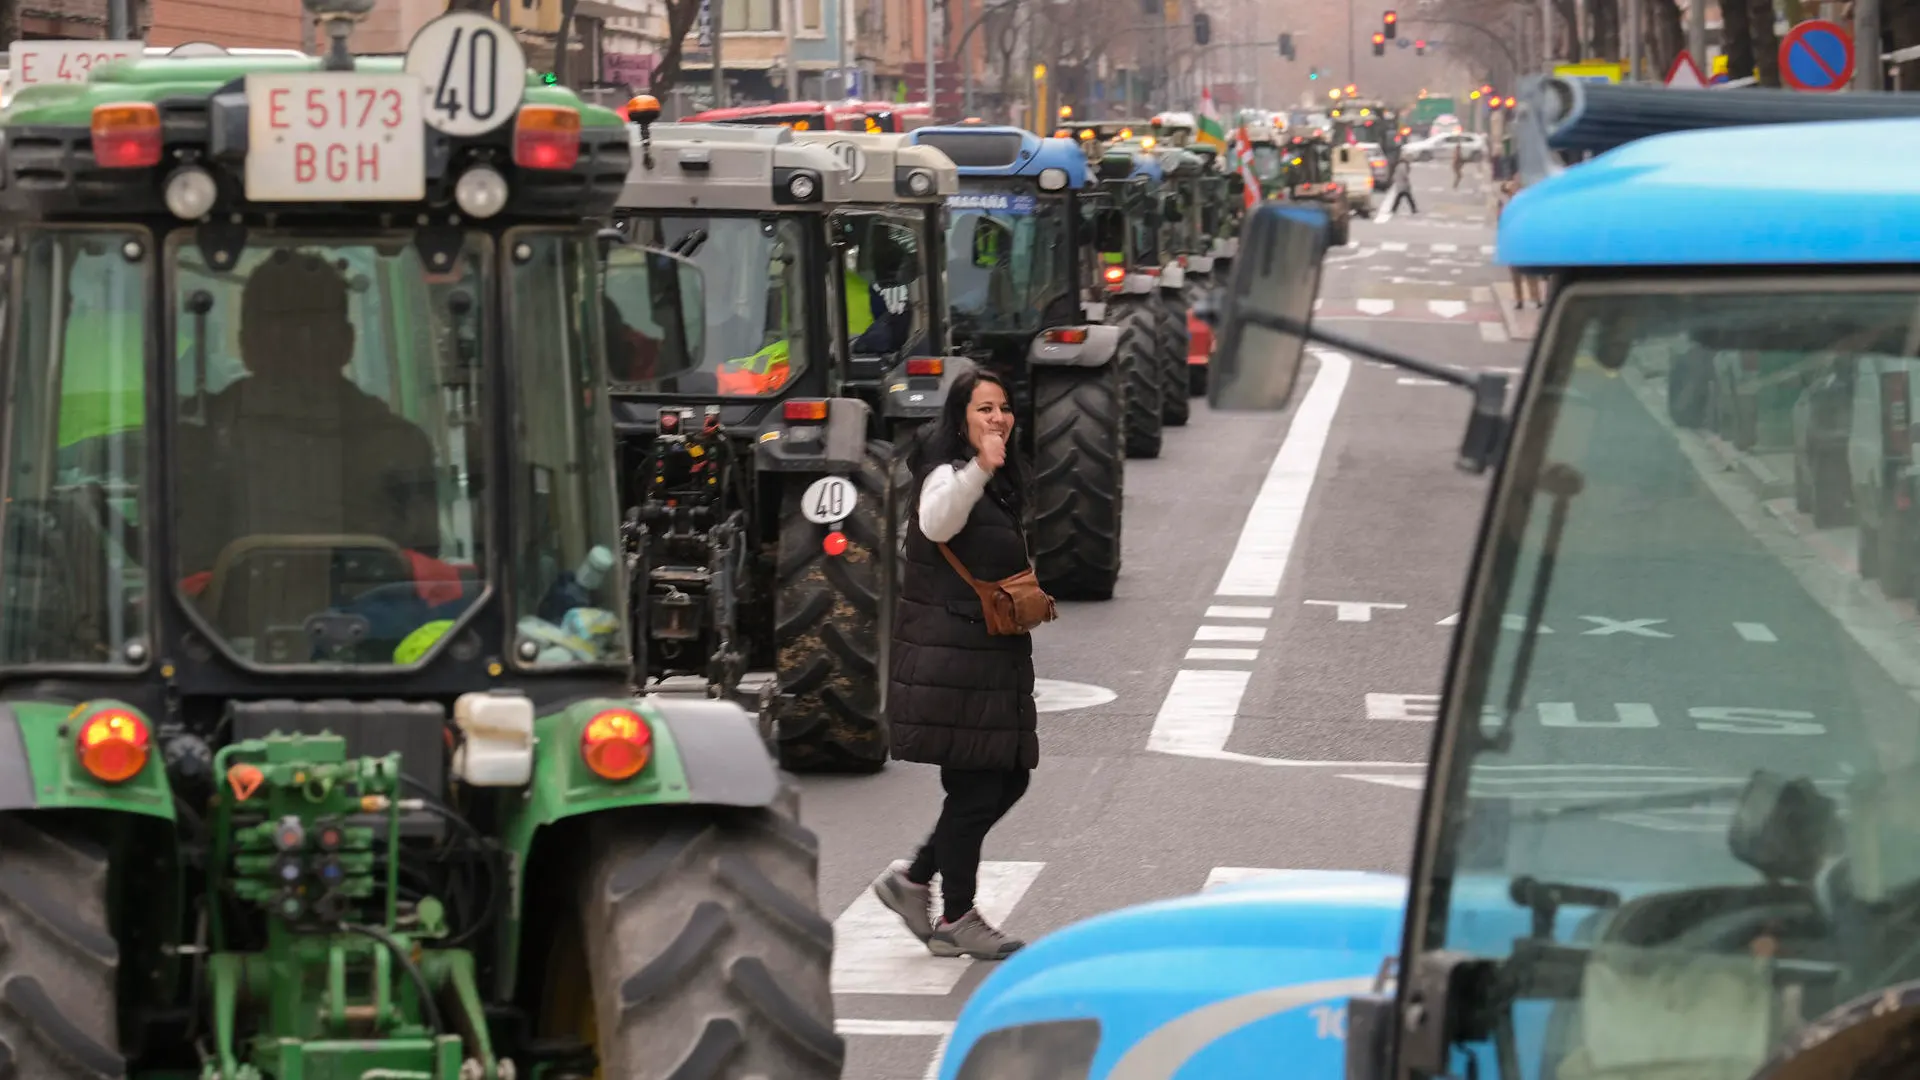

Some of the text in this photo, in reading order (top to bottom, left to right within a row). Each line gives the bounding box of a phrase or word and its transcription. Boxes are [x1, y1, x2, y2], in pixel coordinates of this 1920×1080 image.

[22, 52, 128, 82] E 43
[434, 26, 499, 121] 40
[269, 88, 403, 129] E 5173
[294, 142, 380, 183] BGH
[815, 481, 844, 518] 40
